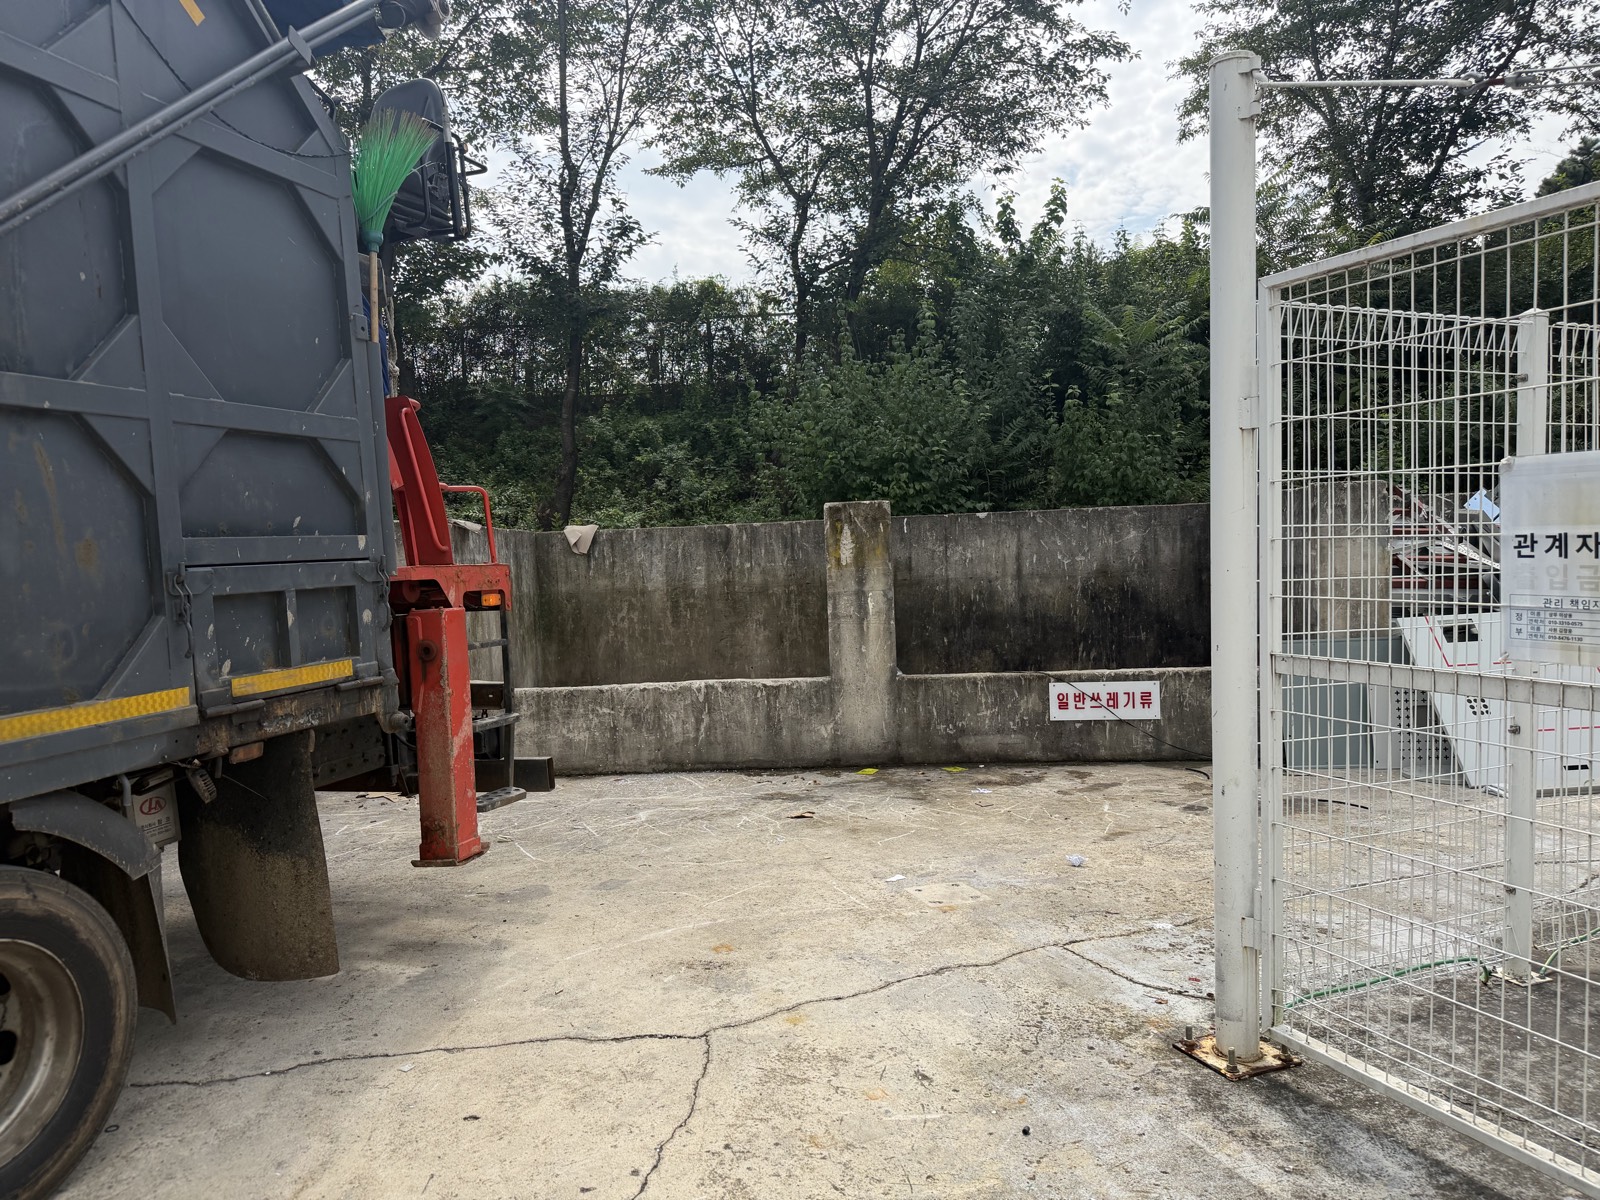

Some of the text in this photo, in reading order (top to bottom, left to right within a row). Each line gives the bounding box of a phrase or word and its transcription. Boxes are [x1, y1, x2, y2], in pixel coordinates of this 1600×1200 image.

[1513, 532, 1600, 559] 관계자
[1513, 563, 1600, 592] 입금
[1543, 598, 1563, 609] 관리
[1515, 612, 1523, 621] 정
[1515, 627, 1523, 636] 부
[1056, 691, 1153, 711] 일반쓰레기류
